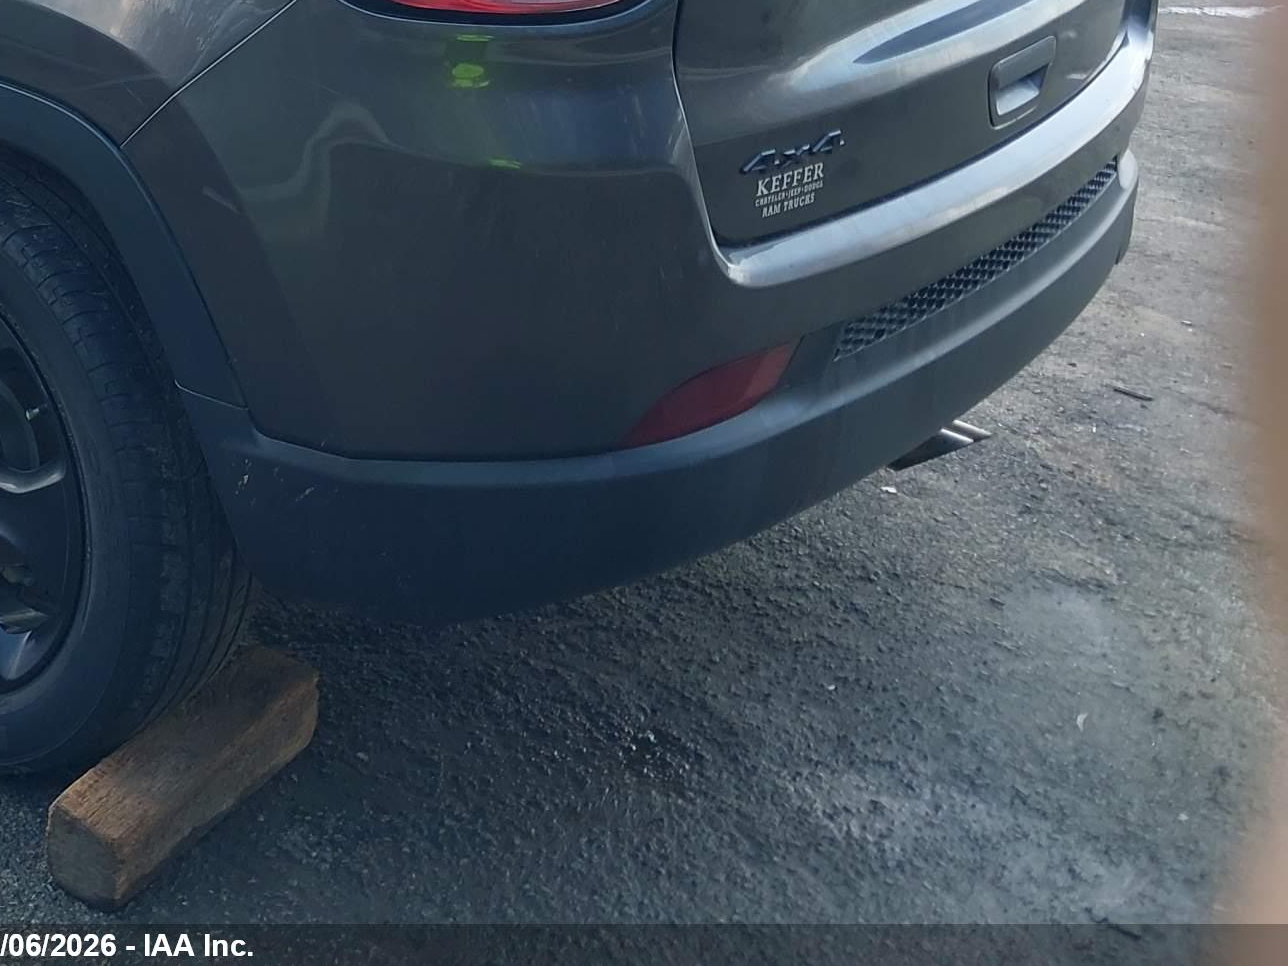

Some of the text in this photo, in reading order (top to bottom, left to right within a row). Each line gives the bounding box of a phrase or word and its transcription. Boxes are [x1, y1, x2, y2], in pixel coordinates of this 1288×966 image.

[756, 162, 825, 197] KEFFER
[762, 192, 816, 219] RAM TRUCKS
